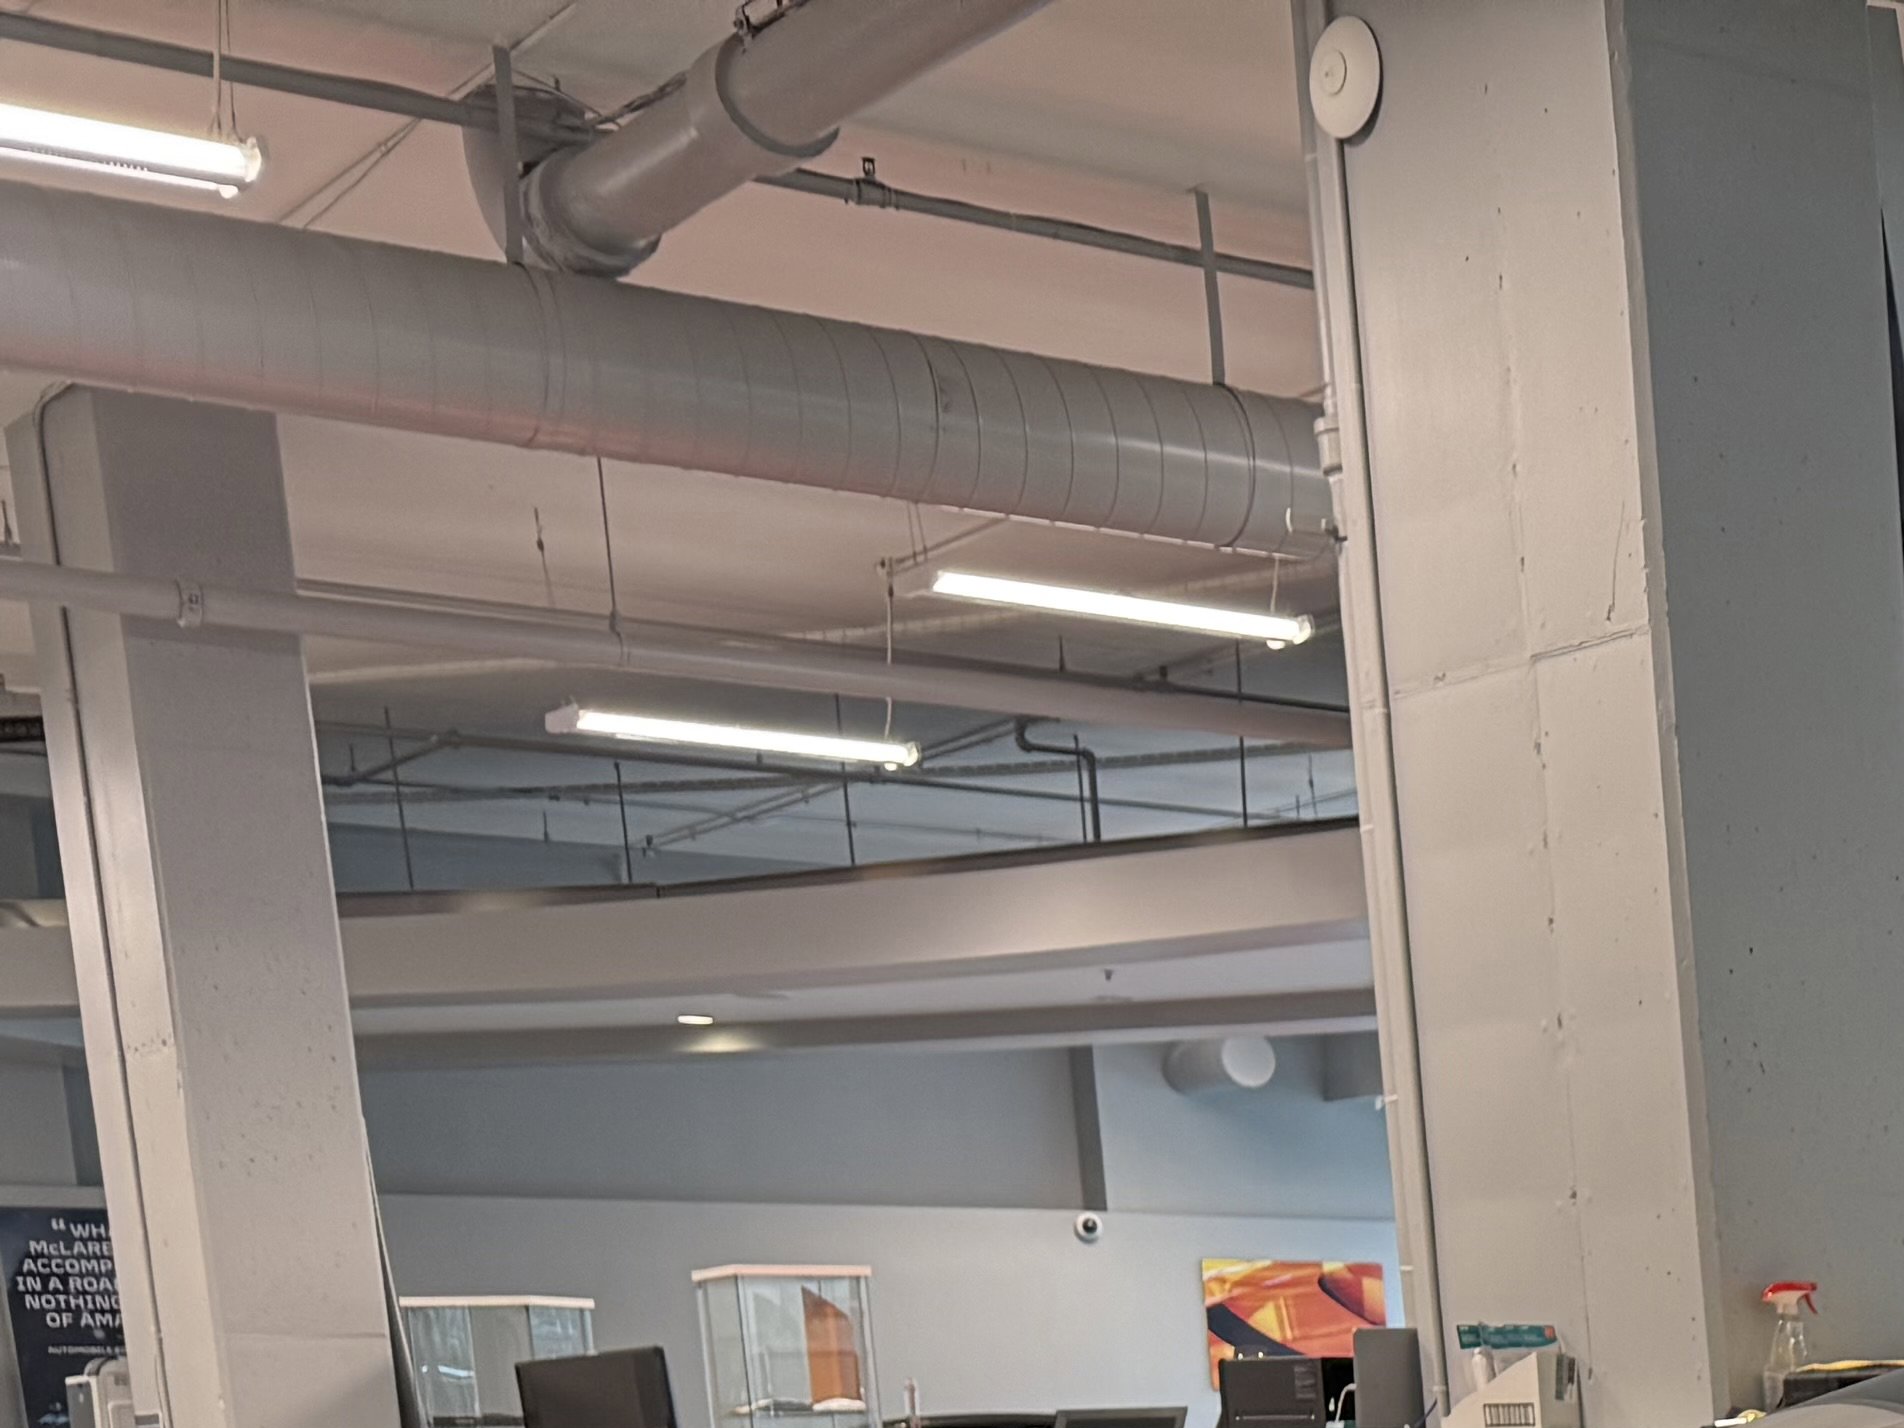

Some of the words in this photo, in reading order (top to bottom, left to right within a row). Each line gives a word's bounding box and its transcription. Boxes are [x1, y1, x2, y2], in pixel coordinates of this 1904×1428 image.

[70, 1223, 110, 1239] WH
[23, 1258, 112, 1274] ACCOMP
[16, 1275, 42, 1292] IN
[48, 1276, 64, 1292] A
[68, 1276, 119, 1293] ROA
[46, 1312, 73, 1328] OF
